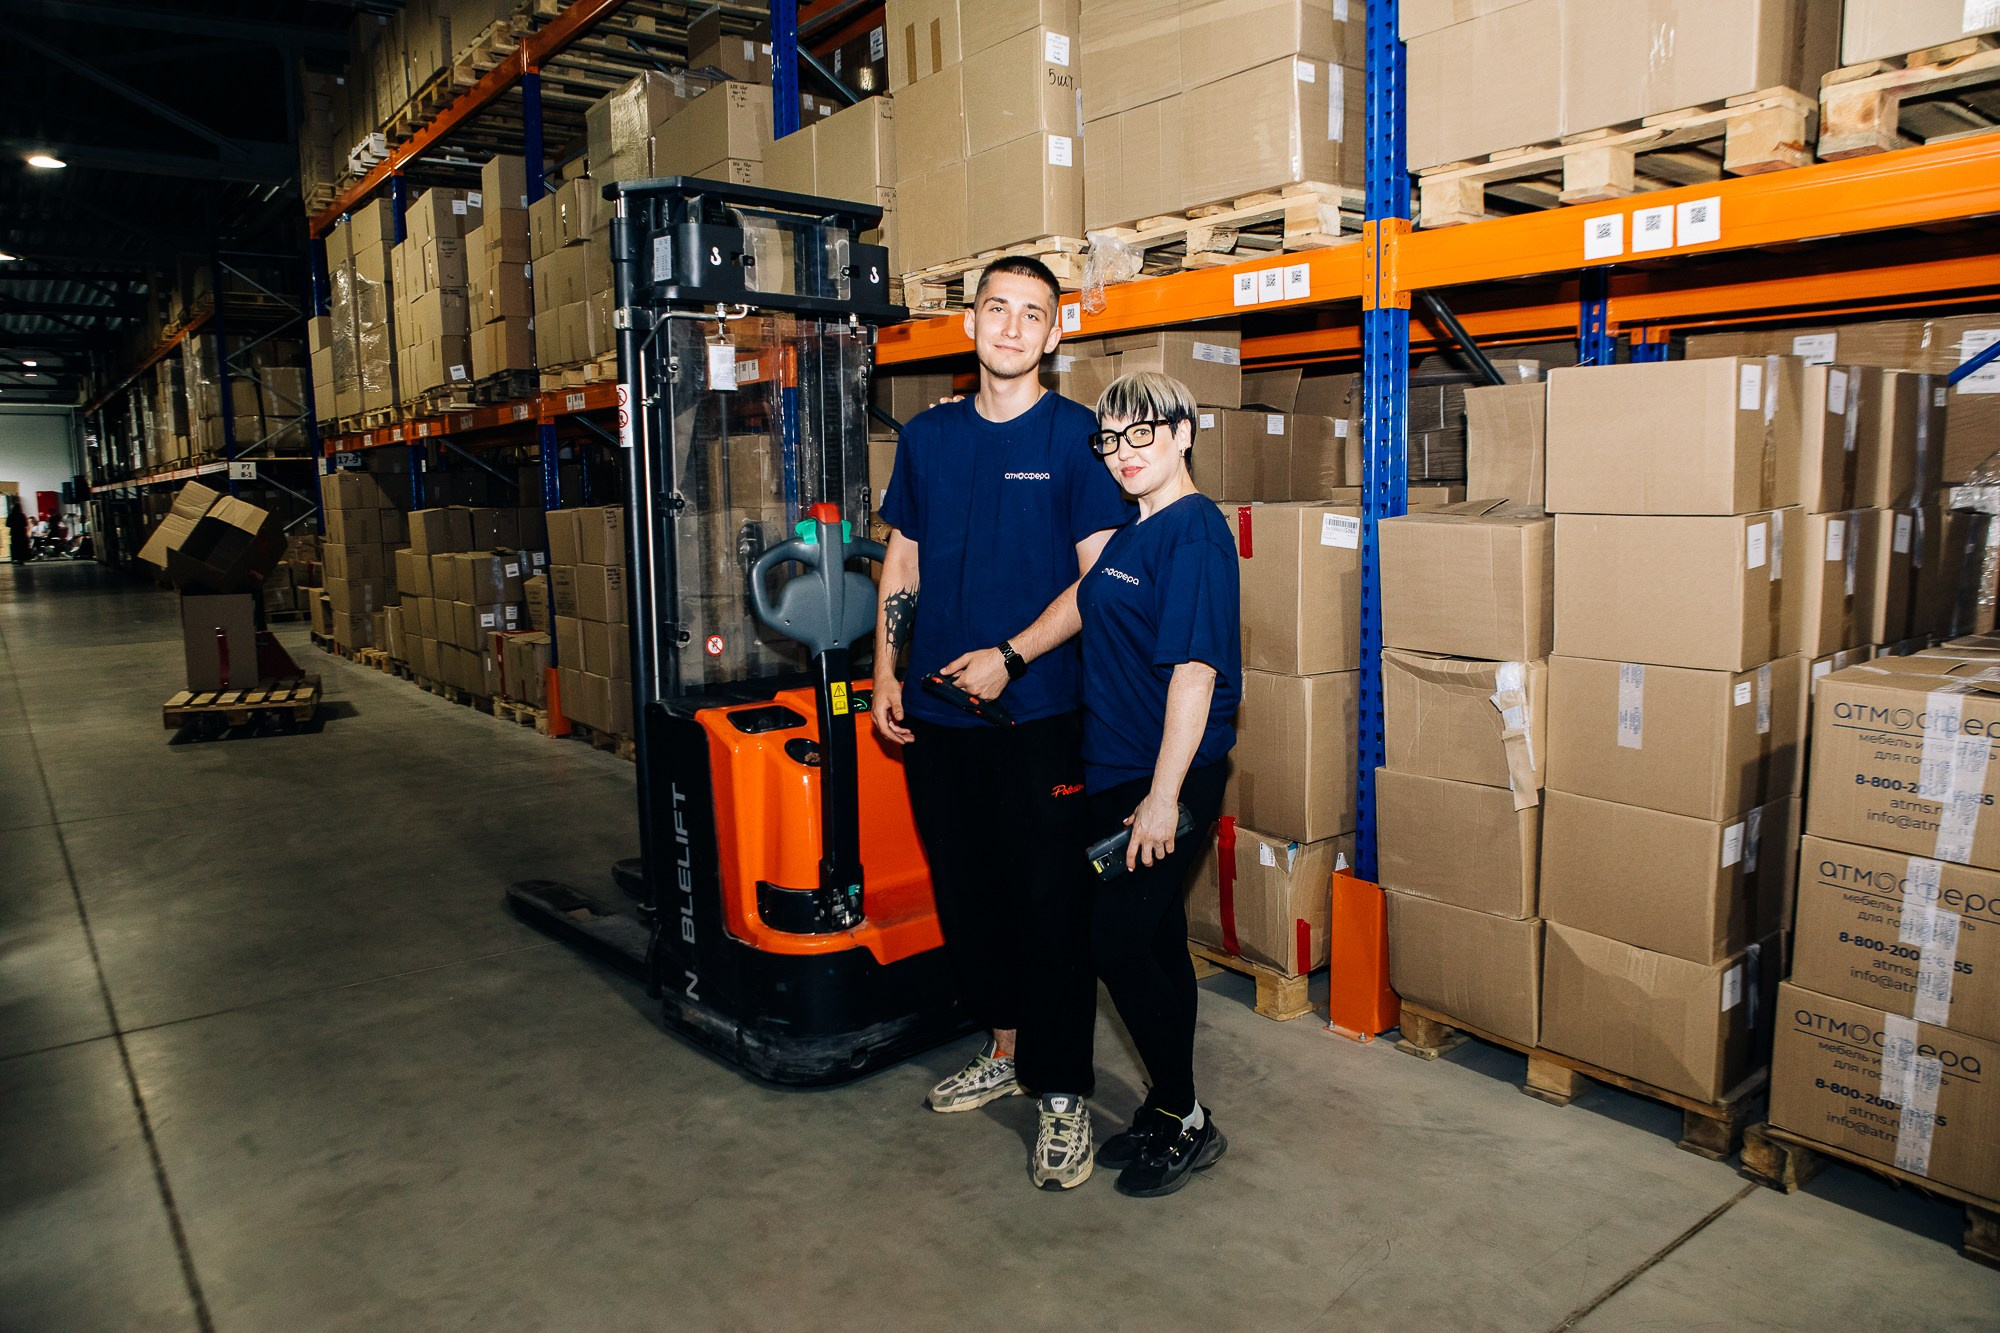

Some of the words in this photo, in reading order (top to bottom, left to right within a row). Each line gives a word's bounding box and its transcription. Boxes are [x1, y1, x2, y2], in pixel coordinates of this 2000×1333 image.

[1101, 567, 1140, 586] осфера
[1859, 734, 1912, 749] мебель
[1874, 751, 1901, 761] для
[1890, 799, 1943, 816] atms.r
[1867, 809, 1941, 832] info@atm
[1843, 894, 1894, 911] мебель
[1857, 911, 1883, 924] для
[1873, 960, 1923, 979] atms.r
[1818, 1042, 1869, 1062] мебель
[1833, 1060, 1859, 1074] для
[1849, 1106, 1900, 1128] atms.r
[1827, 1112, 1899, 1142] info@atm
